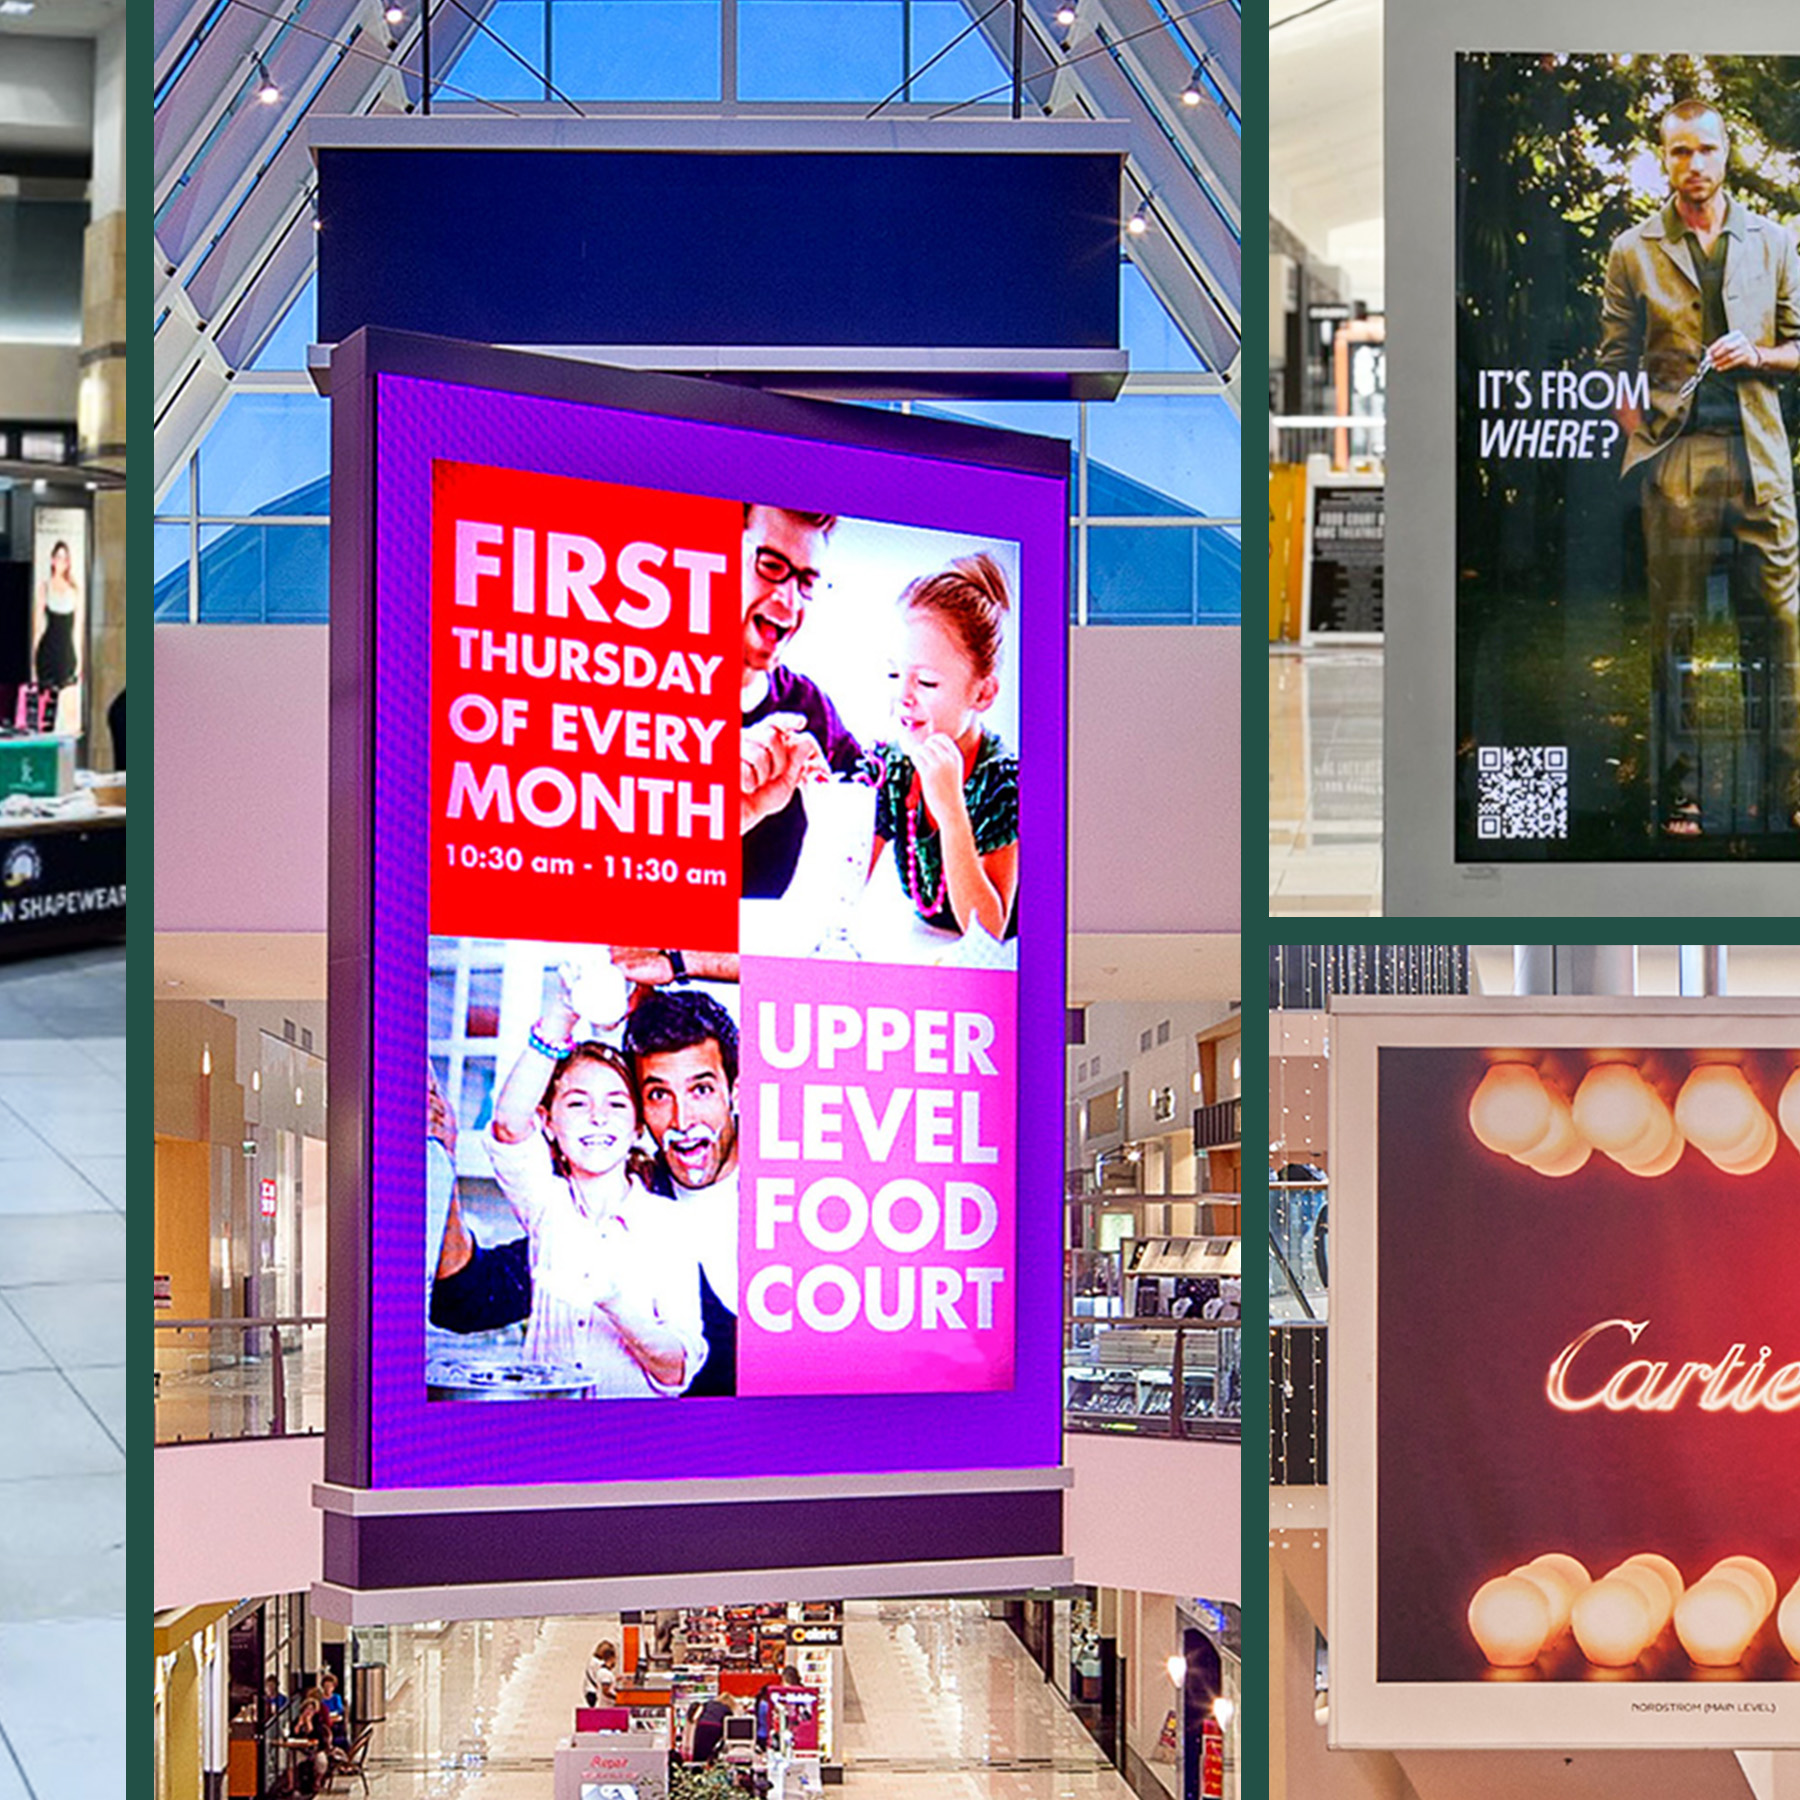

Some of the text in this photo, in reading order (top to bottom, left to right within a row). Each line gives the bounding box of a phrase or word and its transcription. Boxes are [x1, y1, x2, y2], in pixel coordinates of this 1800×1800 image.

[1478, 369, 1651, 411] IT'S FROM
[1480, 418, 1620, 460] WHERE?
[455, 519, 726, 634] FIRST
[452, 627, 723, 695] THURSDAY
[449, 693, 726, 765] OF EVERY
[446, 761, 724, 840] MONTH
[446, 844, 523, 872] 10:30
[531, 856, 574, 875] am
[604, 856, 678, 882] 11:30
[686, 866, 726, 886] am
[759, 1001, 999, 1075] UPPER
[759, 1083, 998, 1163] LEVEL
[755, 1177, 998, 1253] FOOD
[746, 1264, 1005, 1333] COURT
[1631, 1703, 1701, 1713] NORDSTROM
